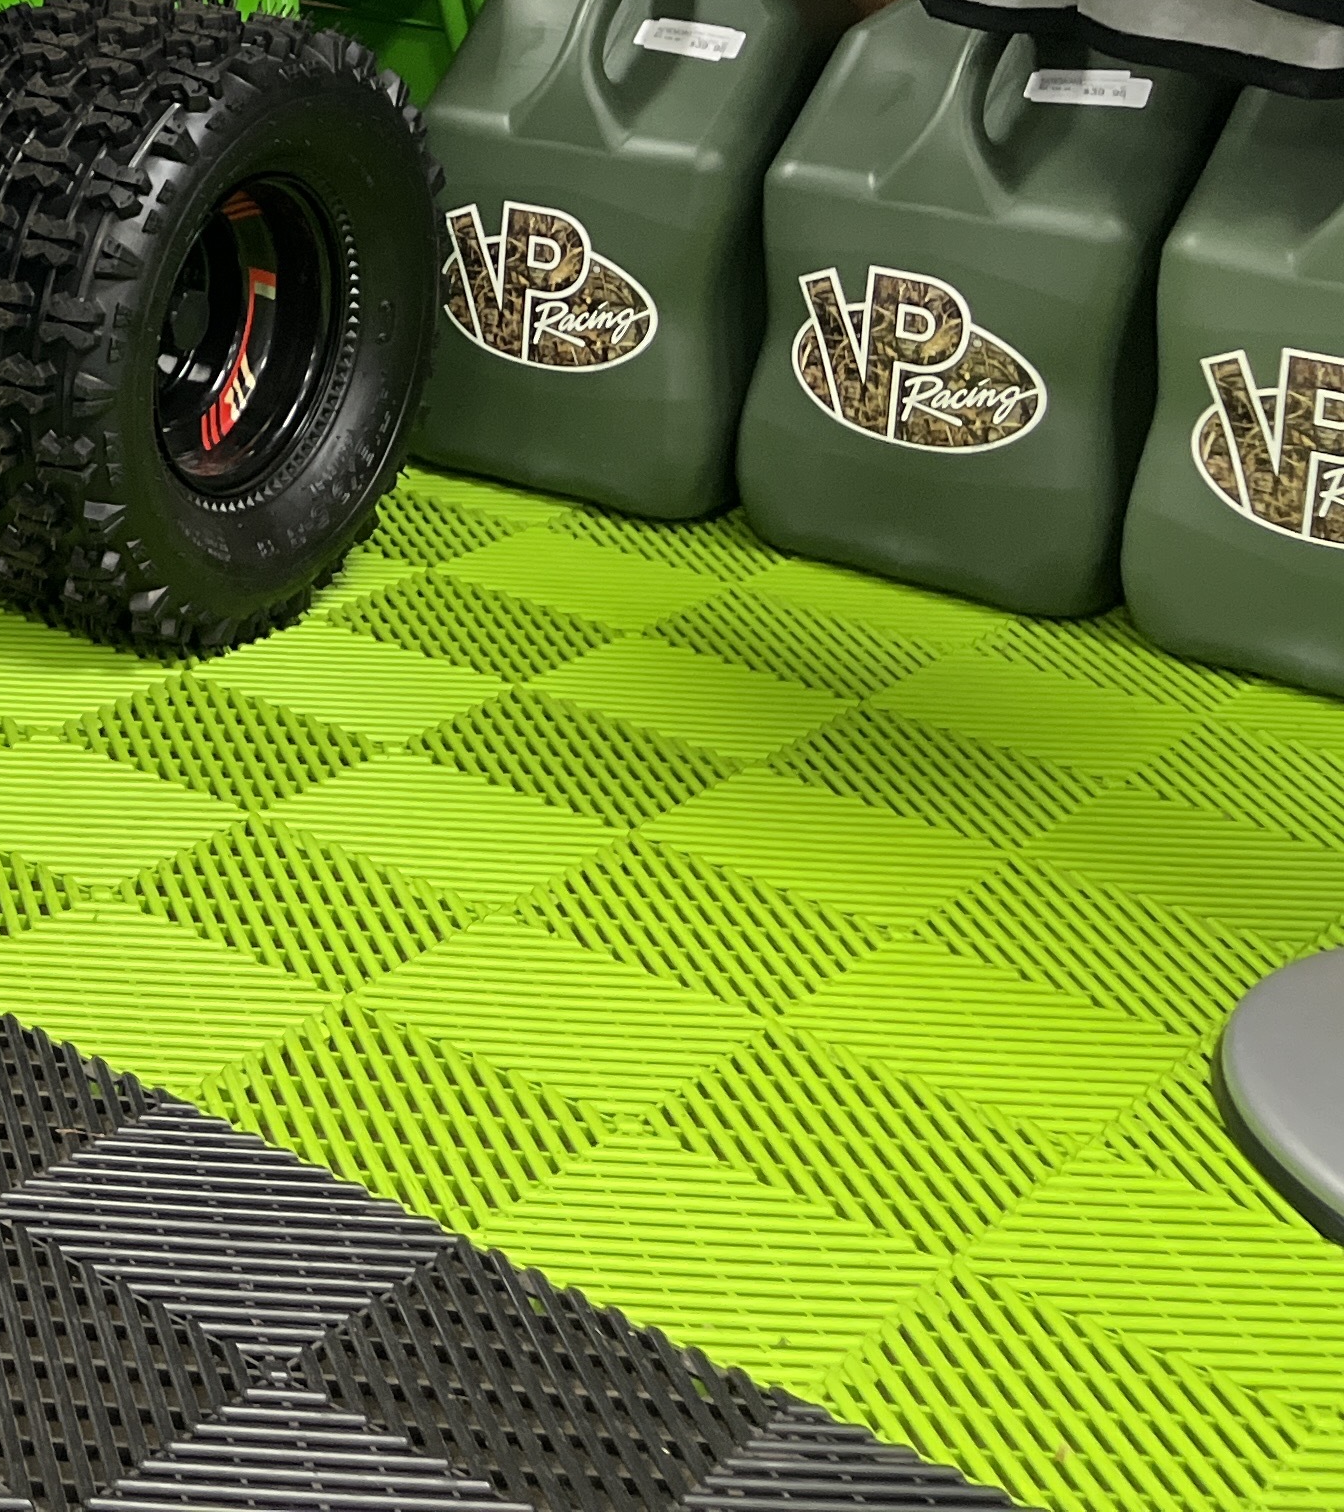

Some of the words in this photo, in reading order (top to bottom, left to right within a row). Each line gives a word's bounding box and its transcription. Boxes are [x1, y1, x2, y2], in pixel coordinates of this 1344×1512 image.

[445, 199, 594, 363] VP
[535, 301, 651, 349] Racing
[798, 264, 974, 440] VP
[902, 375, 1041, 429] Racing
